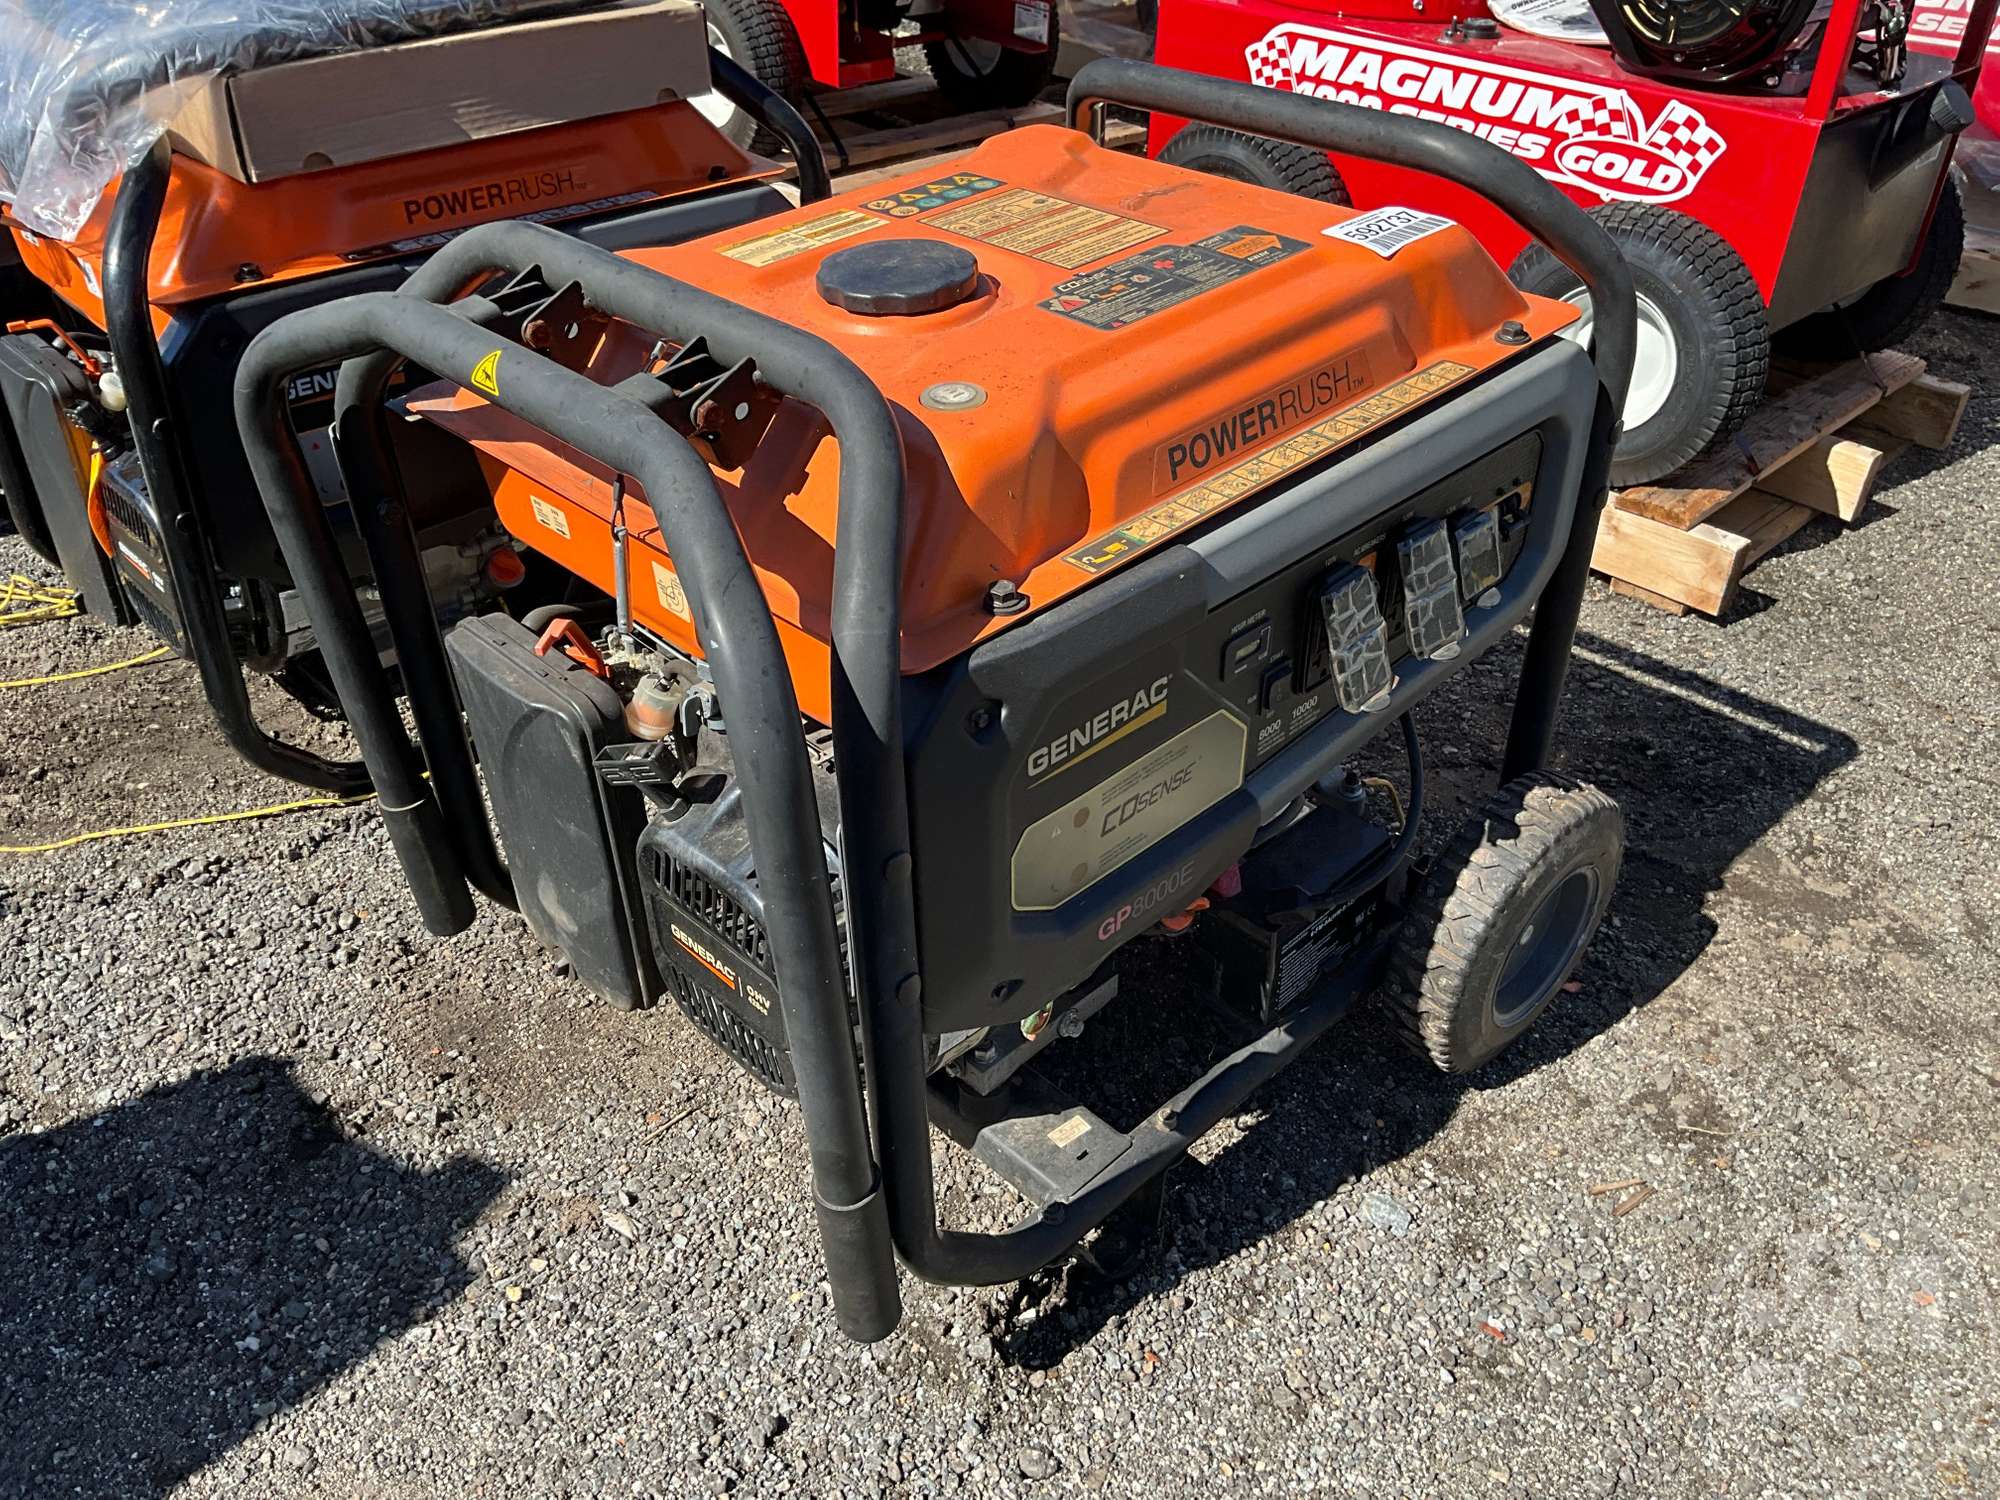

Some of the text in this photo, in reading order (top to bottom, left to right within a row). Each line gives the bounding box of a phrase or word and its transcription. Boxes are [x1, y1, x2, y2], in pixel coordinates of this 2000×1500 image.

[1289, 38, 1588, 137] MAGNUM
[403, 168, 575, 225] POWERRUSH
[1561, 145, 1683, 192] GOLD
[1344, 210, 1419, 241] 592737
[1167, 359, 1352, 481] POWERRUSH
[1027, 676, 1169, 777] GENERAC
[1258, 719, 1282, 741] 8000
[1291, 695, 1319, 720] 10000
[1101, 761, 1197, 838] COSENSE
[1097, 860, 1195, 941] GP8000E
[670, 923, 736, 981] GENERAC
[746, 984, 771, 1009] OHV
